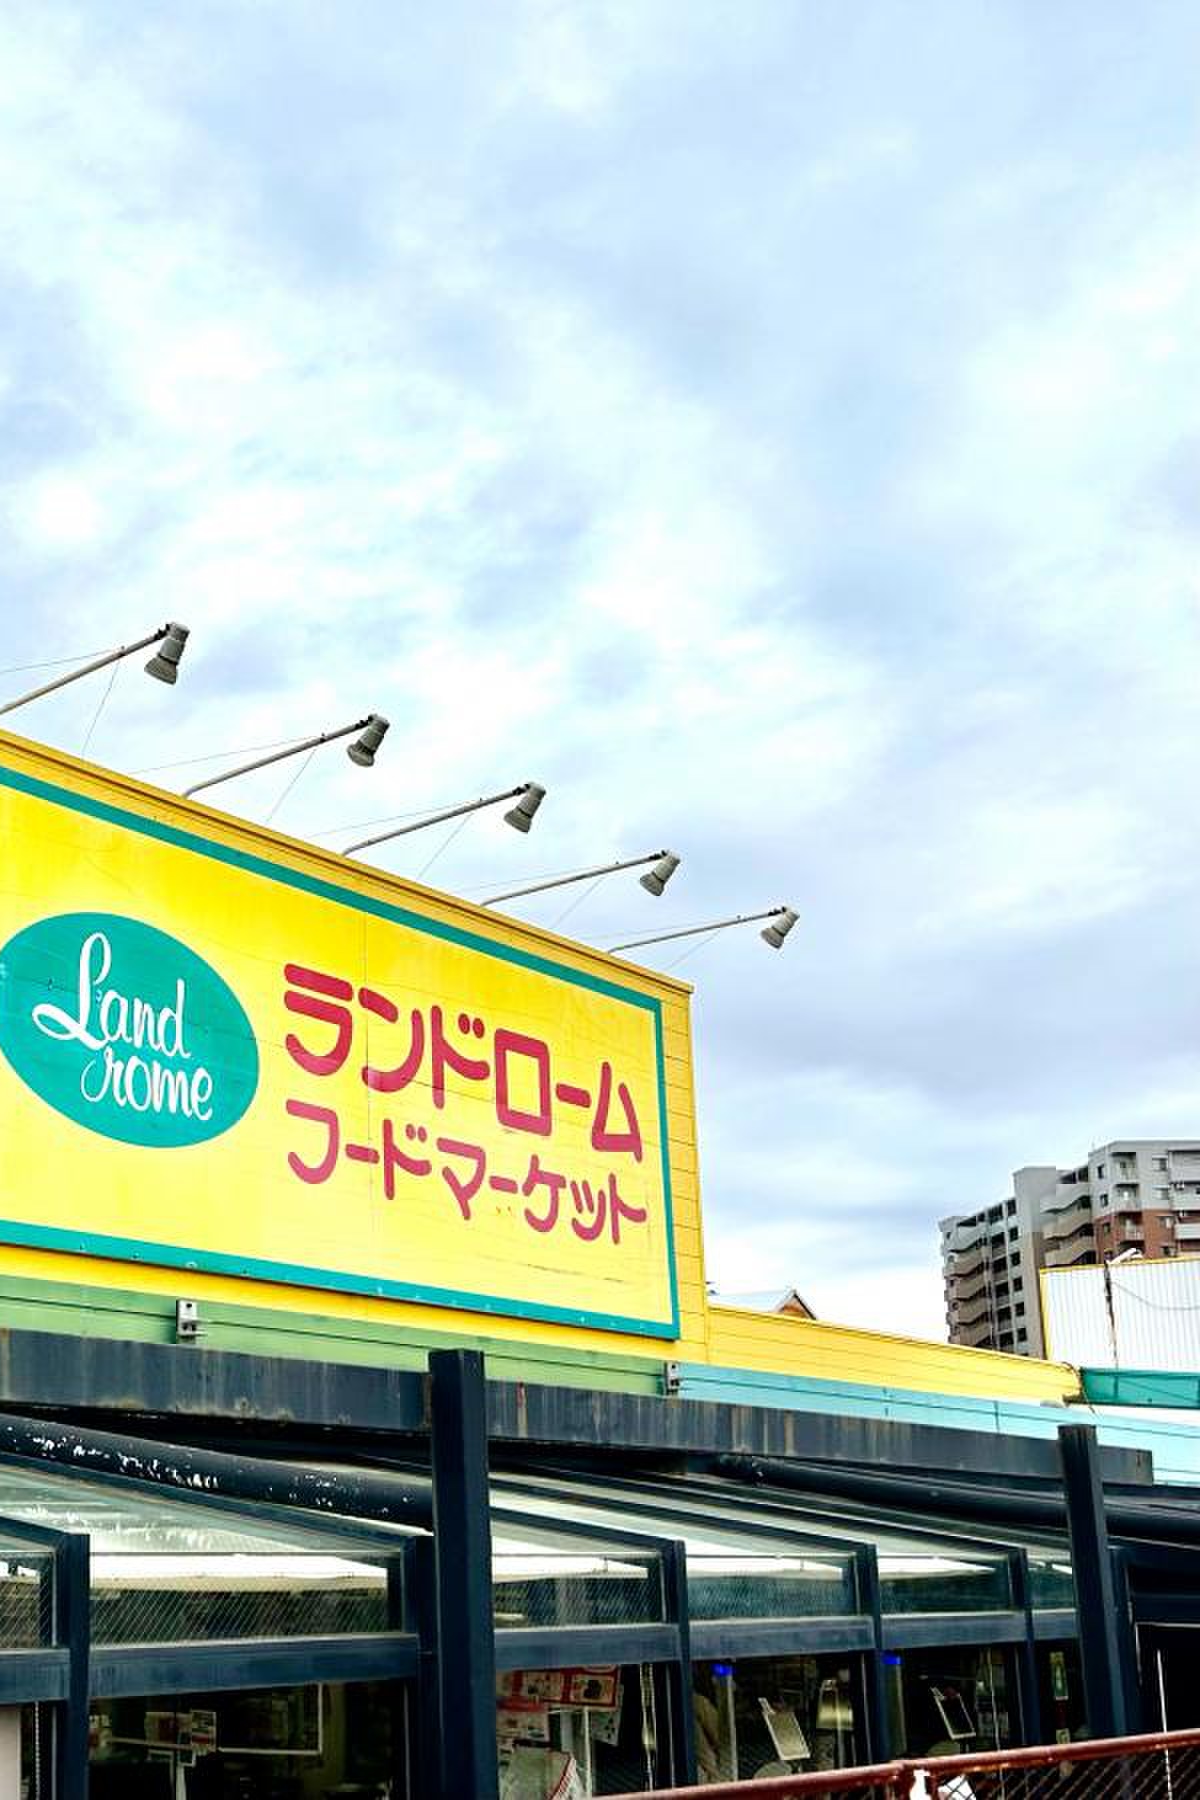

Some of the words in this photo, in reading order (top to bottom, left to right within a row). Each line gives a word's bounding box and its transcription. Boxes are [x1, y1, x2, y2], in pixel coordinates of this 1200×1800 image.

[32, 932, 192, 1058] Land
[283, 963, 644, 1161] ランドローム
[80, 1046, 213, 1121] rome
[285, 1099, 648, 1243] フードマーケット
